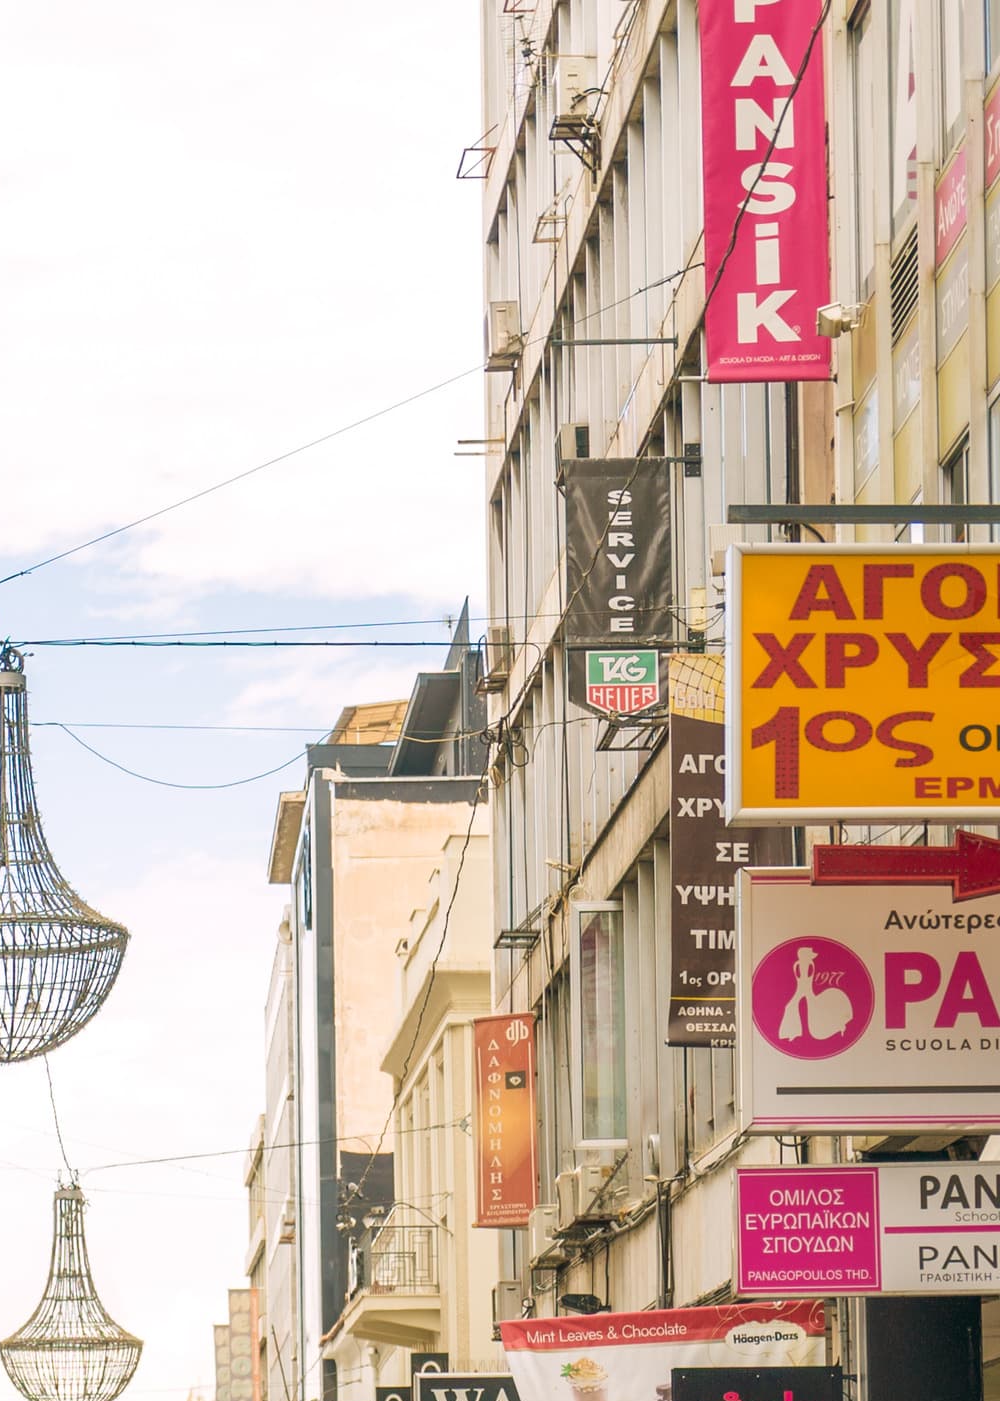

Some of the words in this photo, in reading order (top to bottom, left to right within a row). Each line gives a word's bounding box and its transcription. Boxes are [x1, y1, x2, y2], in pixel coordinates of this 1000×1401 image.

[606, 489, 636, 633] SERVICE
[788, 563, 1000, 621] ΑΓΟ
[598, 655, 648, 683] TAG
[750, 632, 1000, 689] ΧΡΥΣ
[592, 685, 655, 715] HEUER
[959, 723, 1000, 752] Ο
[715, 842, 750, 863] ΣΕ
[814, 971, 845, 986] 1977
[678, 1005, 724, 1017] ΑΘΗΝΑ
[886, 1039, 972, 1051] SCUOLA
[487, 1039, 502, 1201] ΔΑΦΝΟΜΗΛΗΣ
[769, 1188, 845, 1207] ΟΜΙΛΟΣ
[745, 1210, 870, 1231] ΕΥΡΩΠΑΪΚΩΝ
[762, 1236, 854, 1254] ΣΠΟΥΔΩΝ
[748, 1270, 843, 1282] PANAGOPOULOS
[920, 1272, 993, 1283] ΓΡΑΦΙΣΤΙΚΗ
[526, 1329, 555, 1344] Mint
[558, 1329, 603, 1343] Leaves
[607, 1325, 618, 1340] &
[621, 1322, 688, 1339] Chocolate
[733, 1331, 799, 1345] Häagen-Dazs
